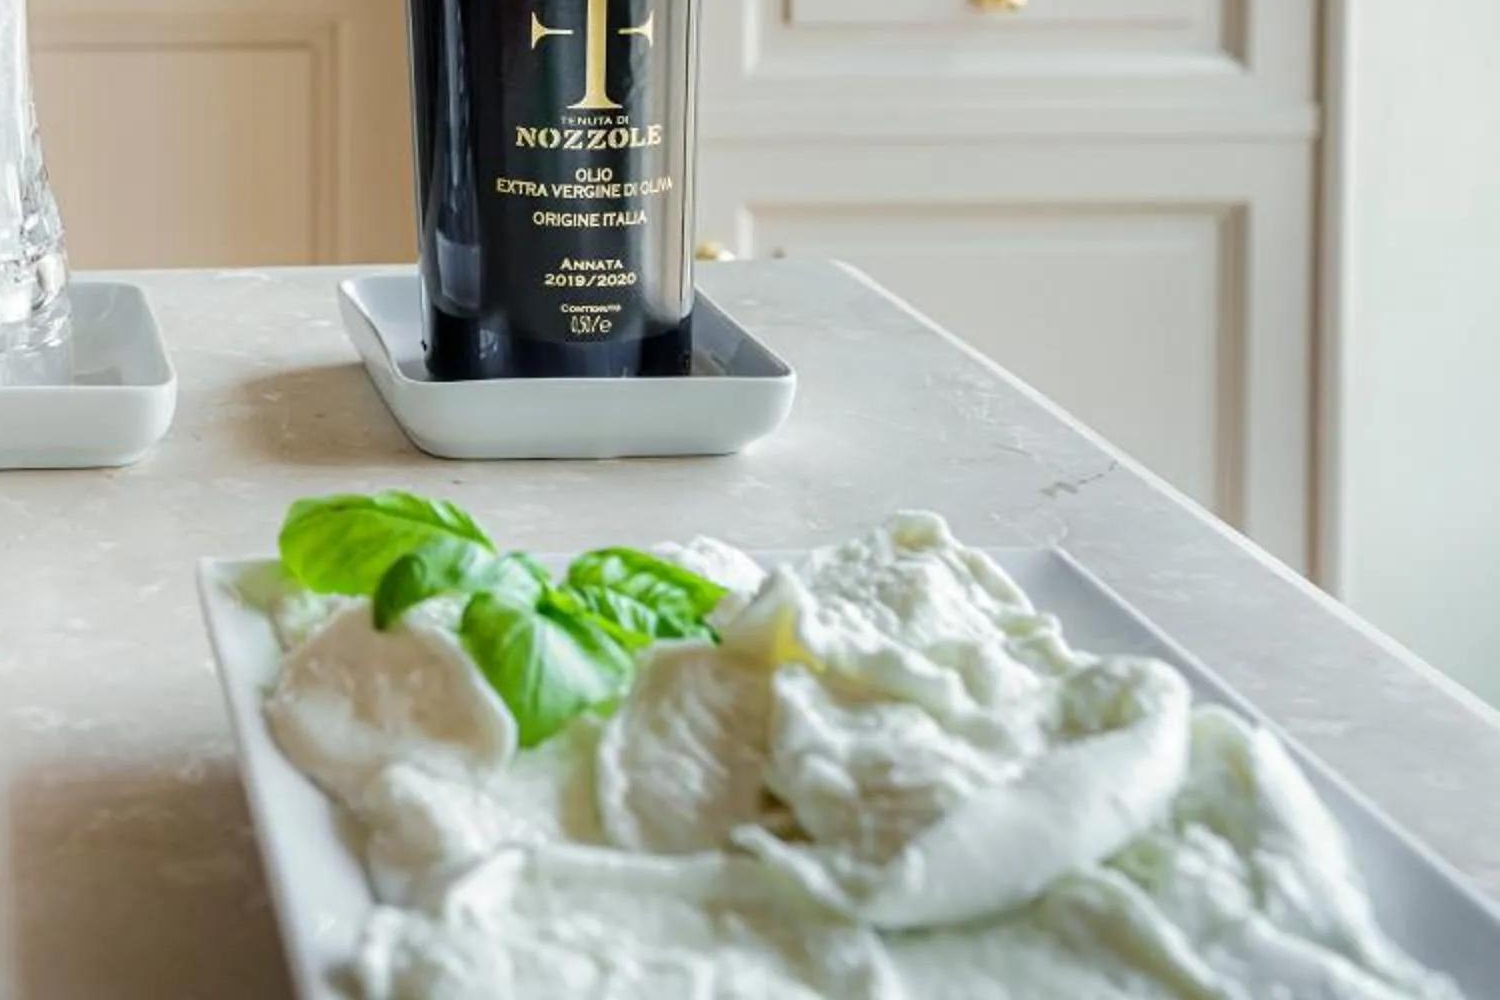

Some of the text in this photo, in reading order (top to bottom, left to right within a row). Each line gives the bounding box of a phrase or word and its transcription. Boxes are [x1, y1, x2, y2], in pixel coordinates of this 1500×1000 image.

[560, 115, 629, 126] TENUTA DI
[515, 124, 664, 150] NOZZOLE
[575, 167, 613, 183] OLIO
[496, 175, 674, 199] EXTRA VERGINE DI OLIVA
[533, 209, 647, 227] ORIGINE ITALIA
[560, 257, 623, 271] ANNATA
[544, 271, 638, 288] 2019/2020
